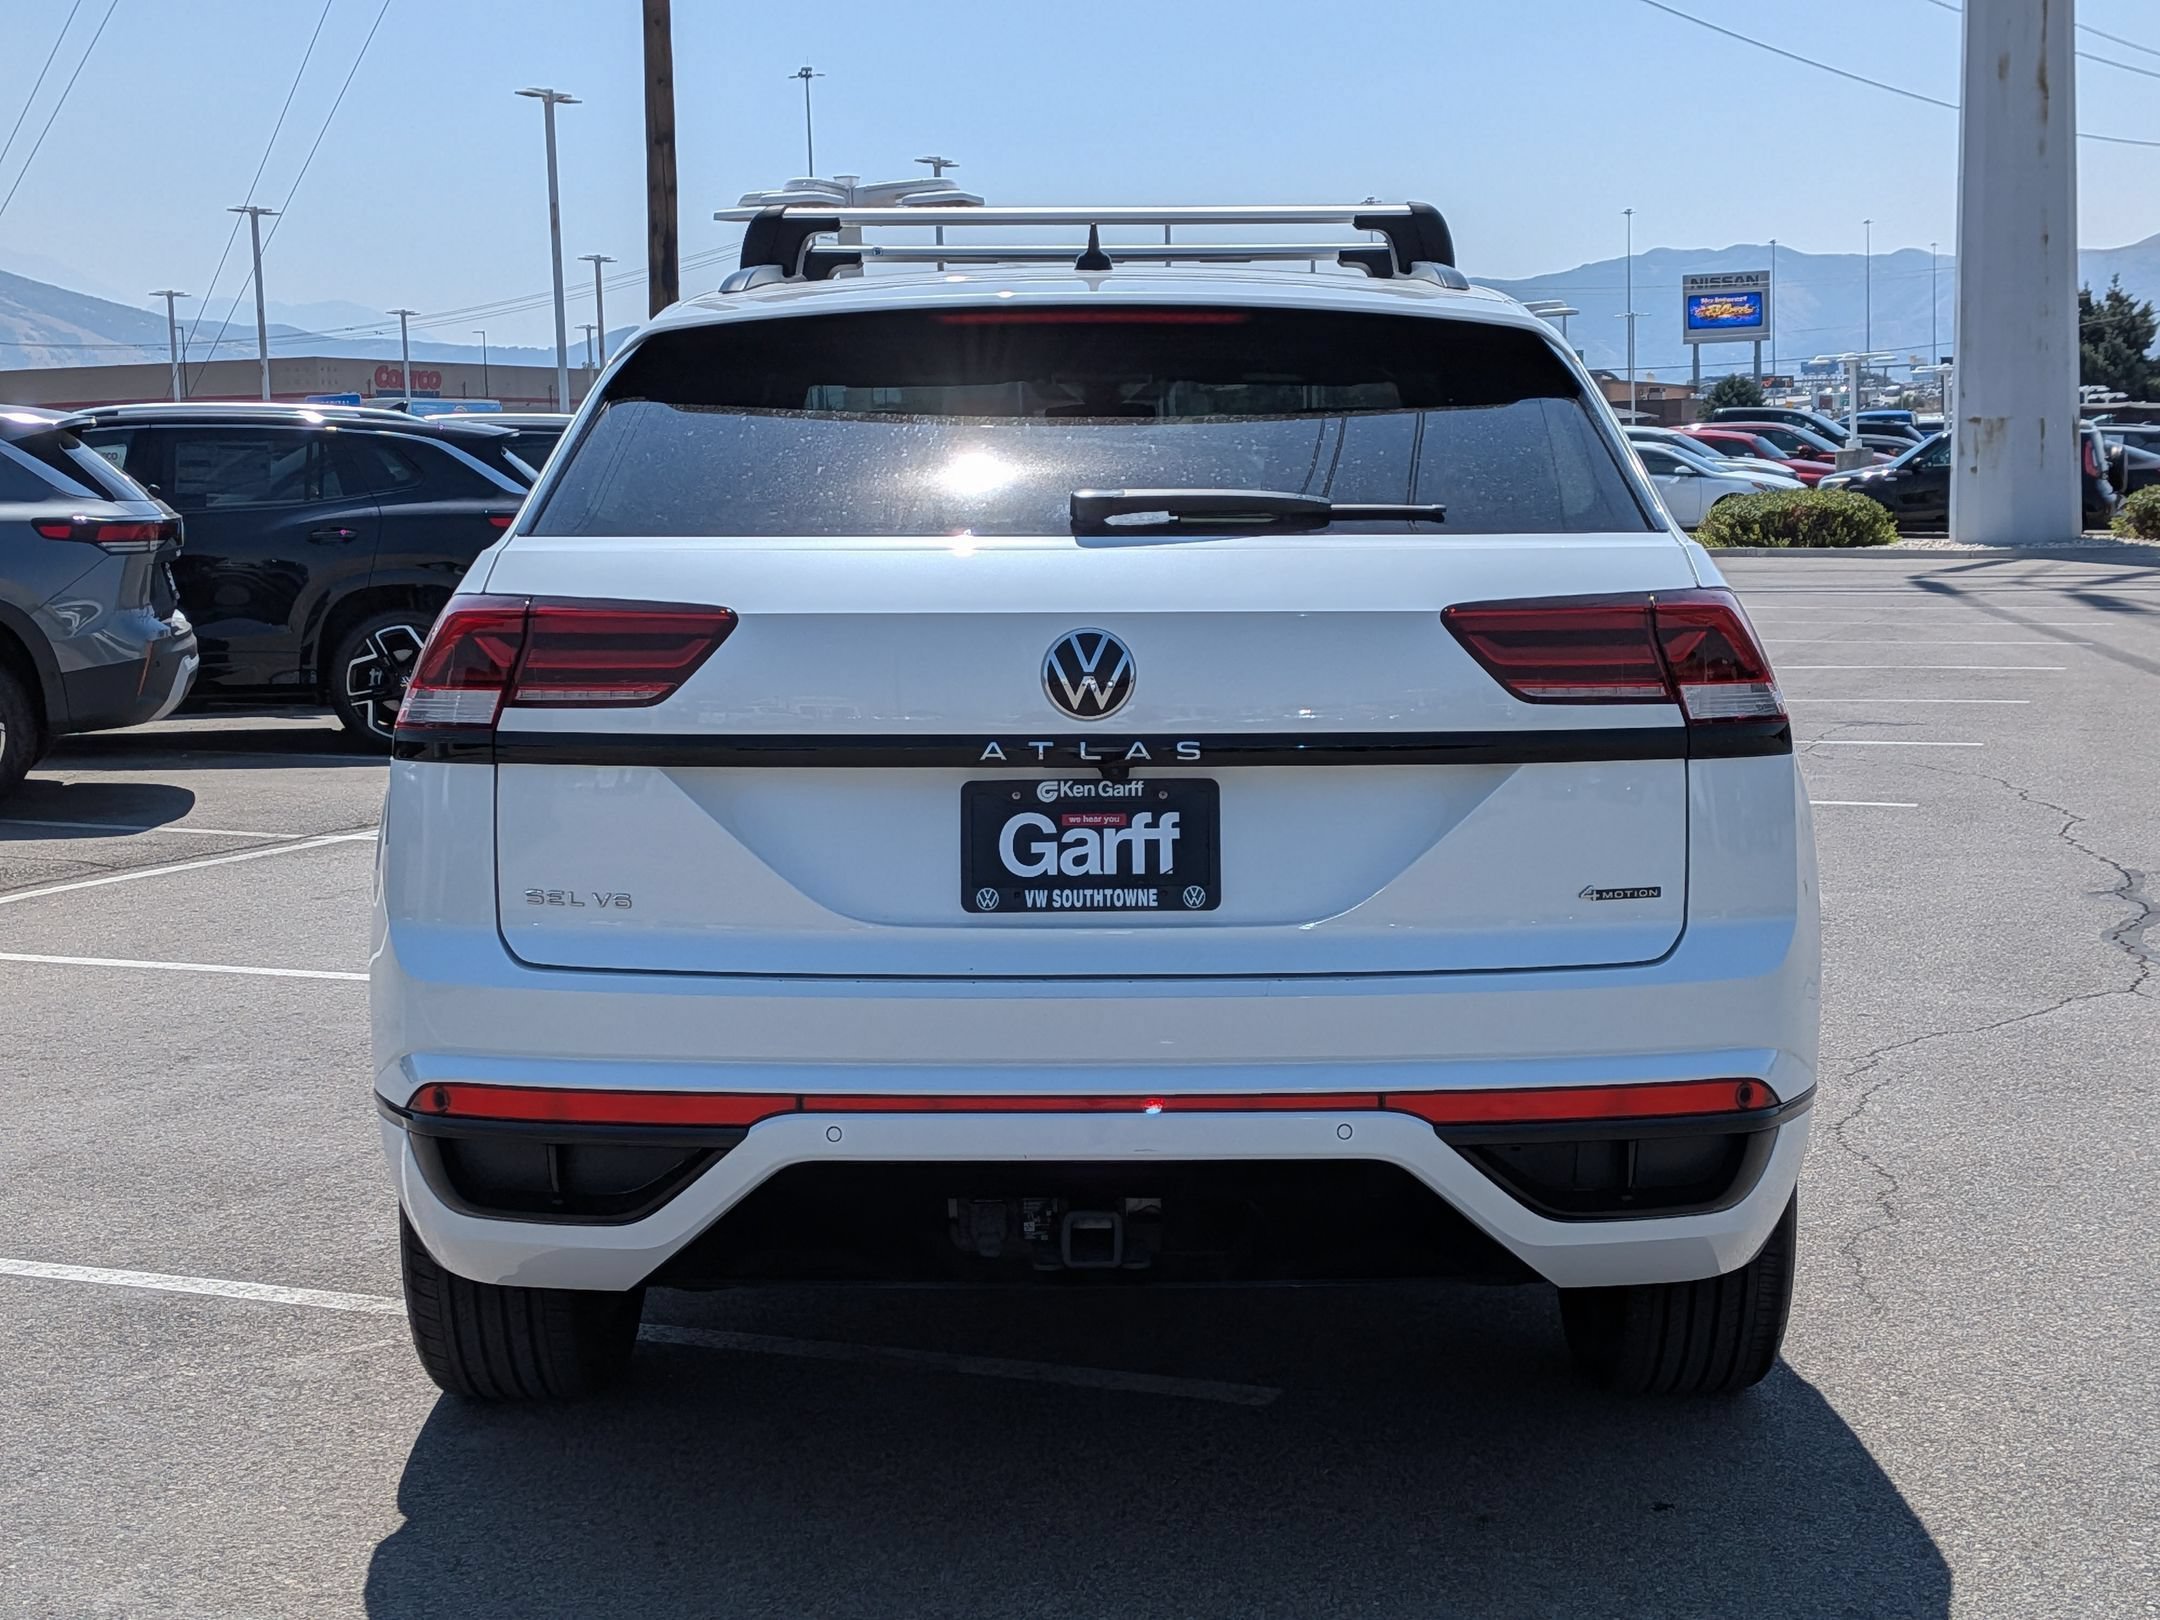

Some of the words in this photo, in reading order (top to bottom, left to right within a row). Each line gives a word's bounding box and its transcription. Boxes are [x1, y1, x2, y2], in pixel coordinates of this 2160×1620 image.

[1690, 274, 1759, 289] NISSAN
[374, 364, 442, 390] COTCO
[979, 741, 1201, 761] ATLAS
[1060, 781, 1096, 798] Ken
[1098, 780, 1144, 798] Garff
[1083, 814, 1102, 823] hear
[1103, 815, 1120, 825] you
[999, 811, 1181, 878] Garff
[524, 888, 586, 908] SEL
[591, 891, 633, 910] V6
[1024, 889, 1048, 908] VW
[1052, 888, 1158, 908] SOUTHTOWNE
